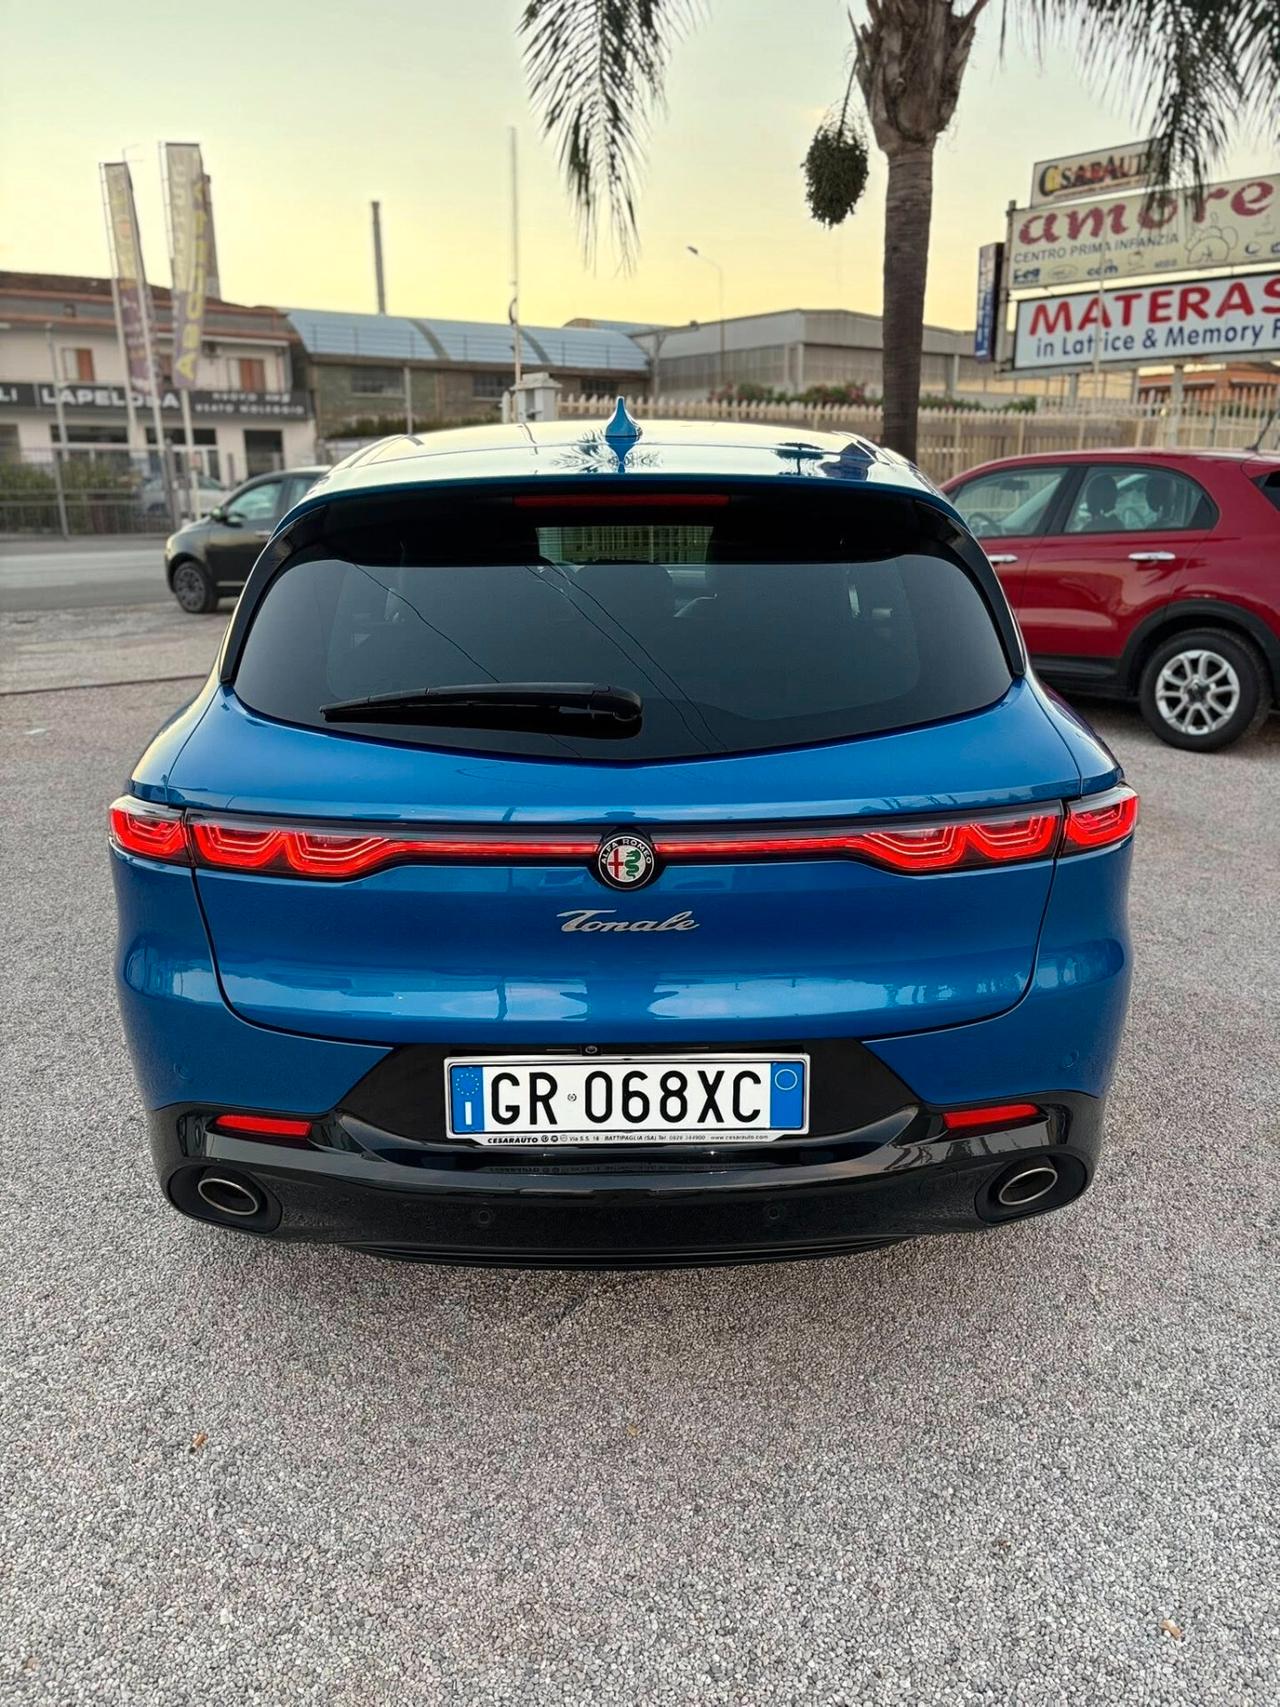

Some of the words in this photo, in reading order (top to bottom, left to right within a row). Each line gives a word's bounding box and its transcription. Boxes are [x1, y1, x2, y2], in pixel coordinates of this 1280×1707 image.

[1014, 248, 1066, 264] CENTRO
[1070, 241, 1112, 257] PRIMA
[1115, 233, 1180, 252] INFANZIA
[1036, 339, 1054, 357] in
[1062, 333, 1135, 355] Latice
[1142, 327, 1158, 349] &
[1165, 323, 1264, 346] Memory
[601, 842, 619, 864] ALFA
[622, 839, 652, 864] ROMEO
[556, 909, 700, 932] Tonale
[490, 1072, 558, 1126] GR
[584, 1070, 762, 1124] 068XC
